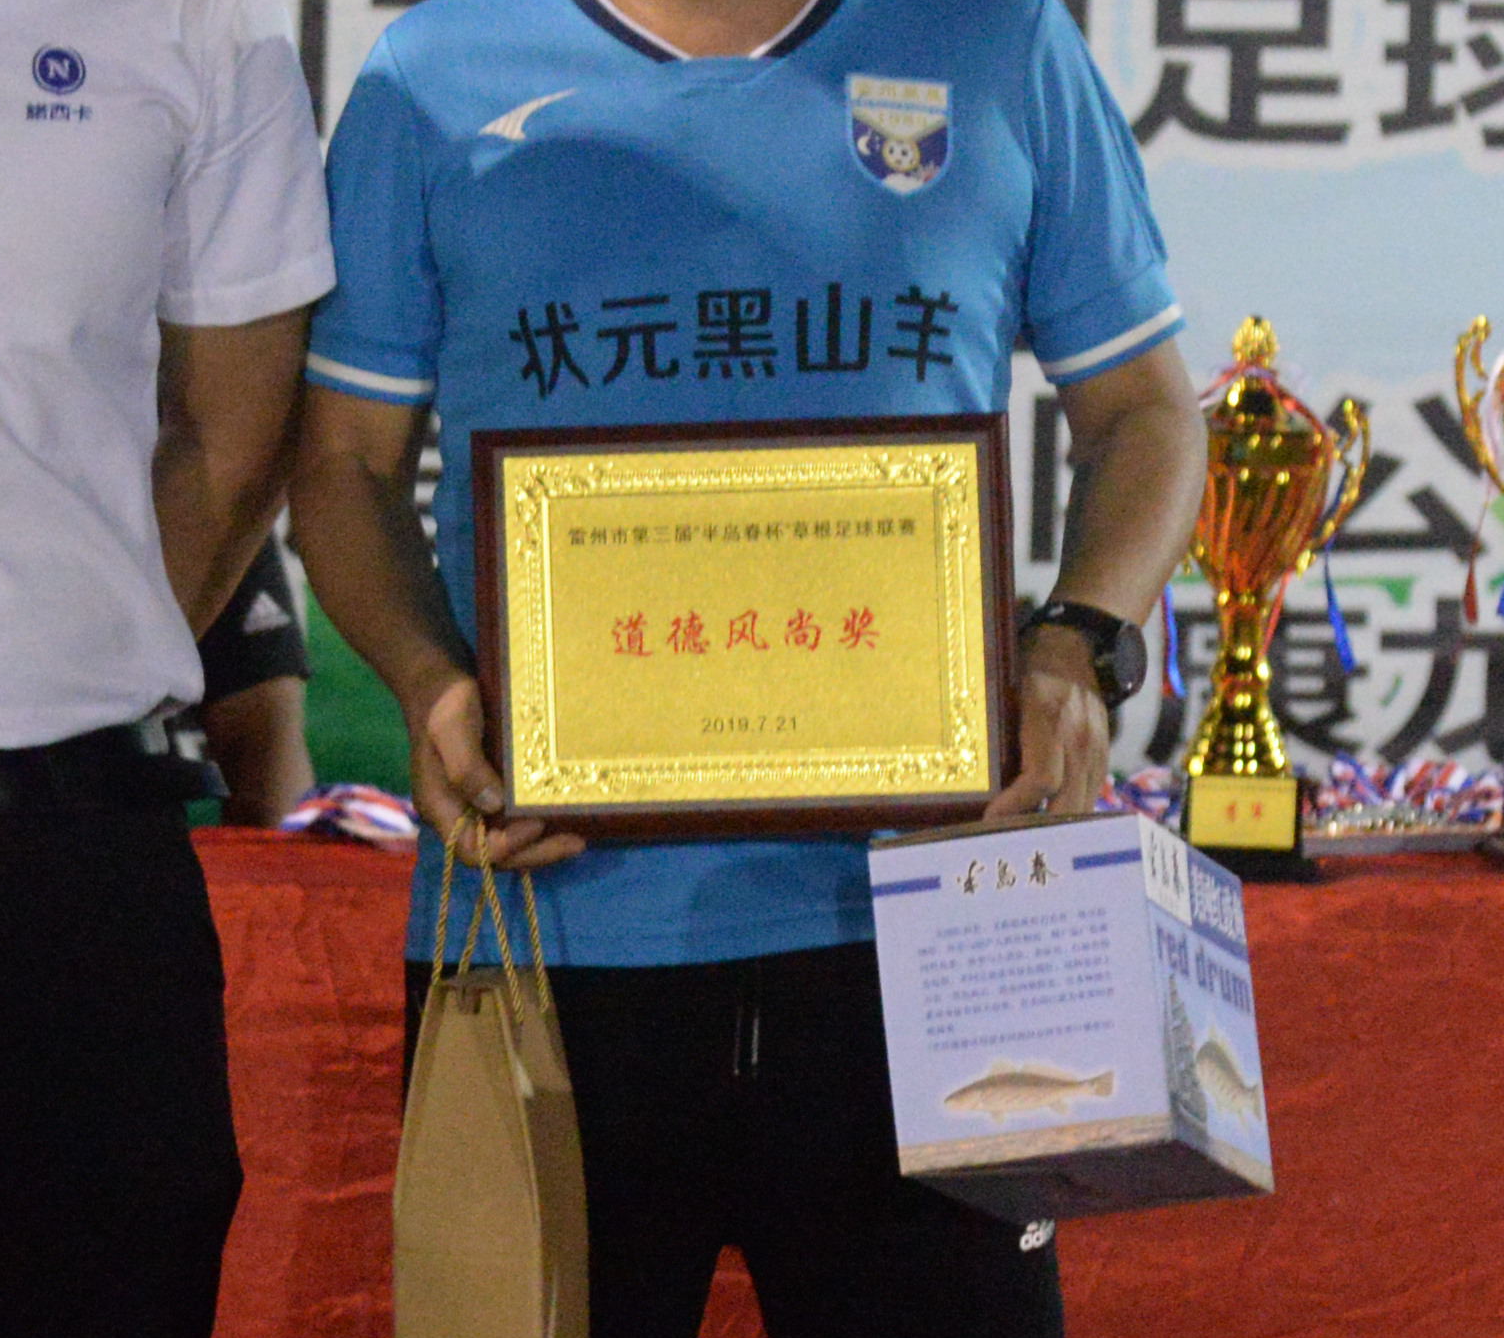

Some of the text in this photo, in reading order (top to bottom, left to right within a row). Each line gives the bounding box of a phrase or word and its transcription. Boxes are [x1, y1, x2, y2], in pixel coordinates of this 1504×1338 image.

[508, 281, 960, 399] 状元黑山羊
[610, 606, 882, 658] 道德风尚奖
